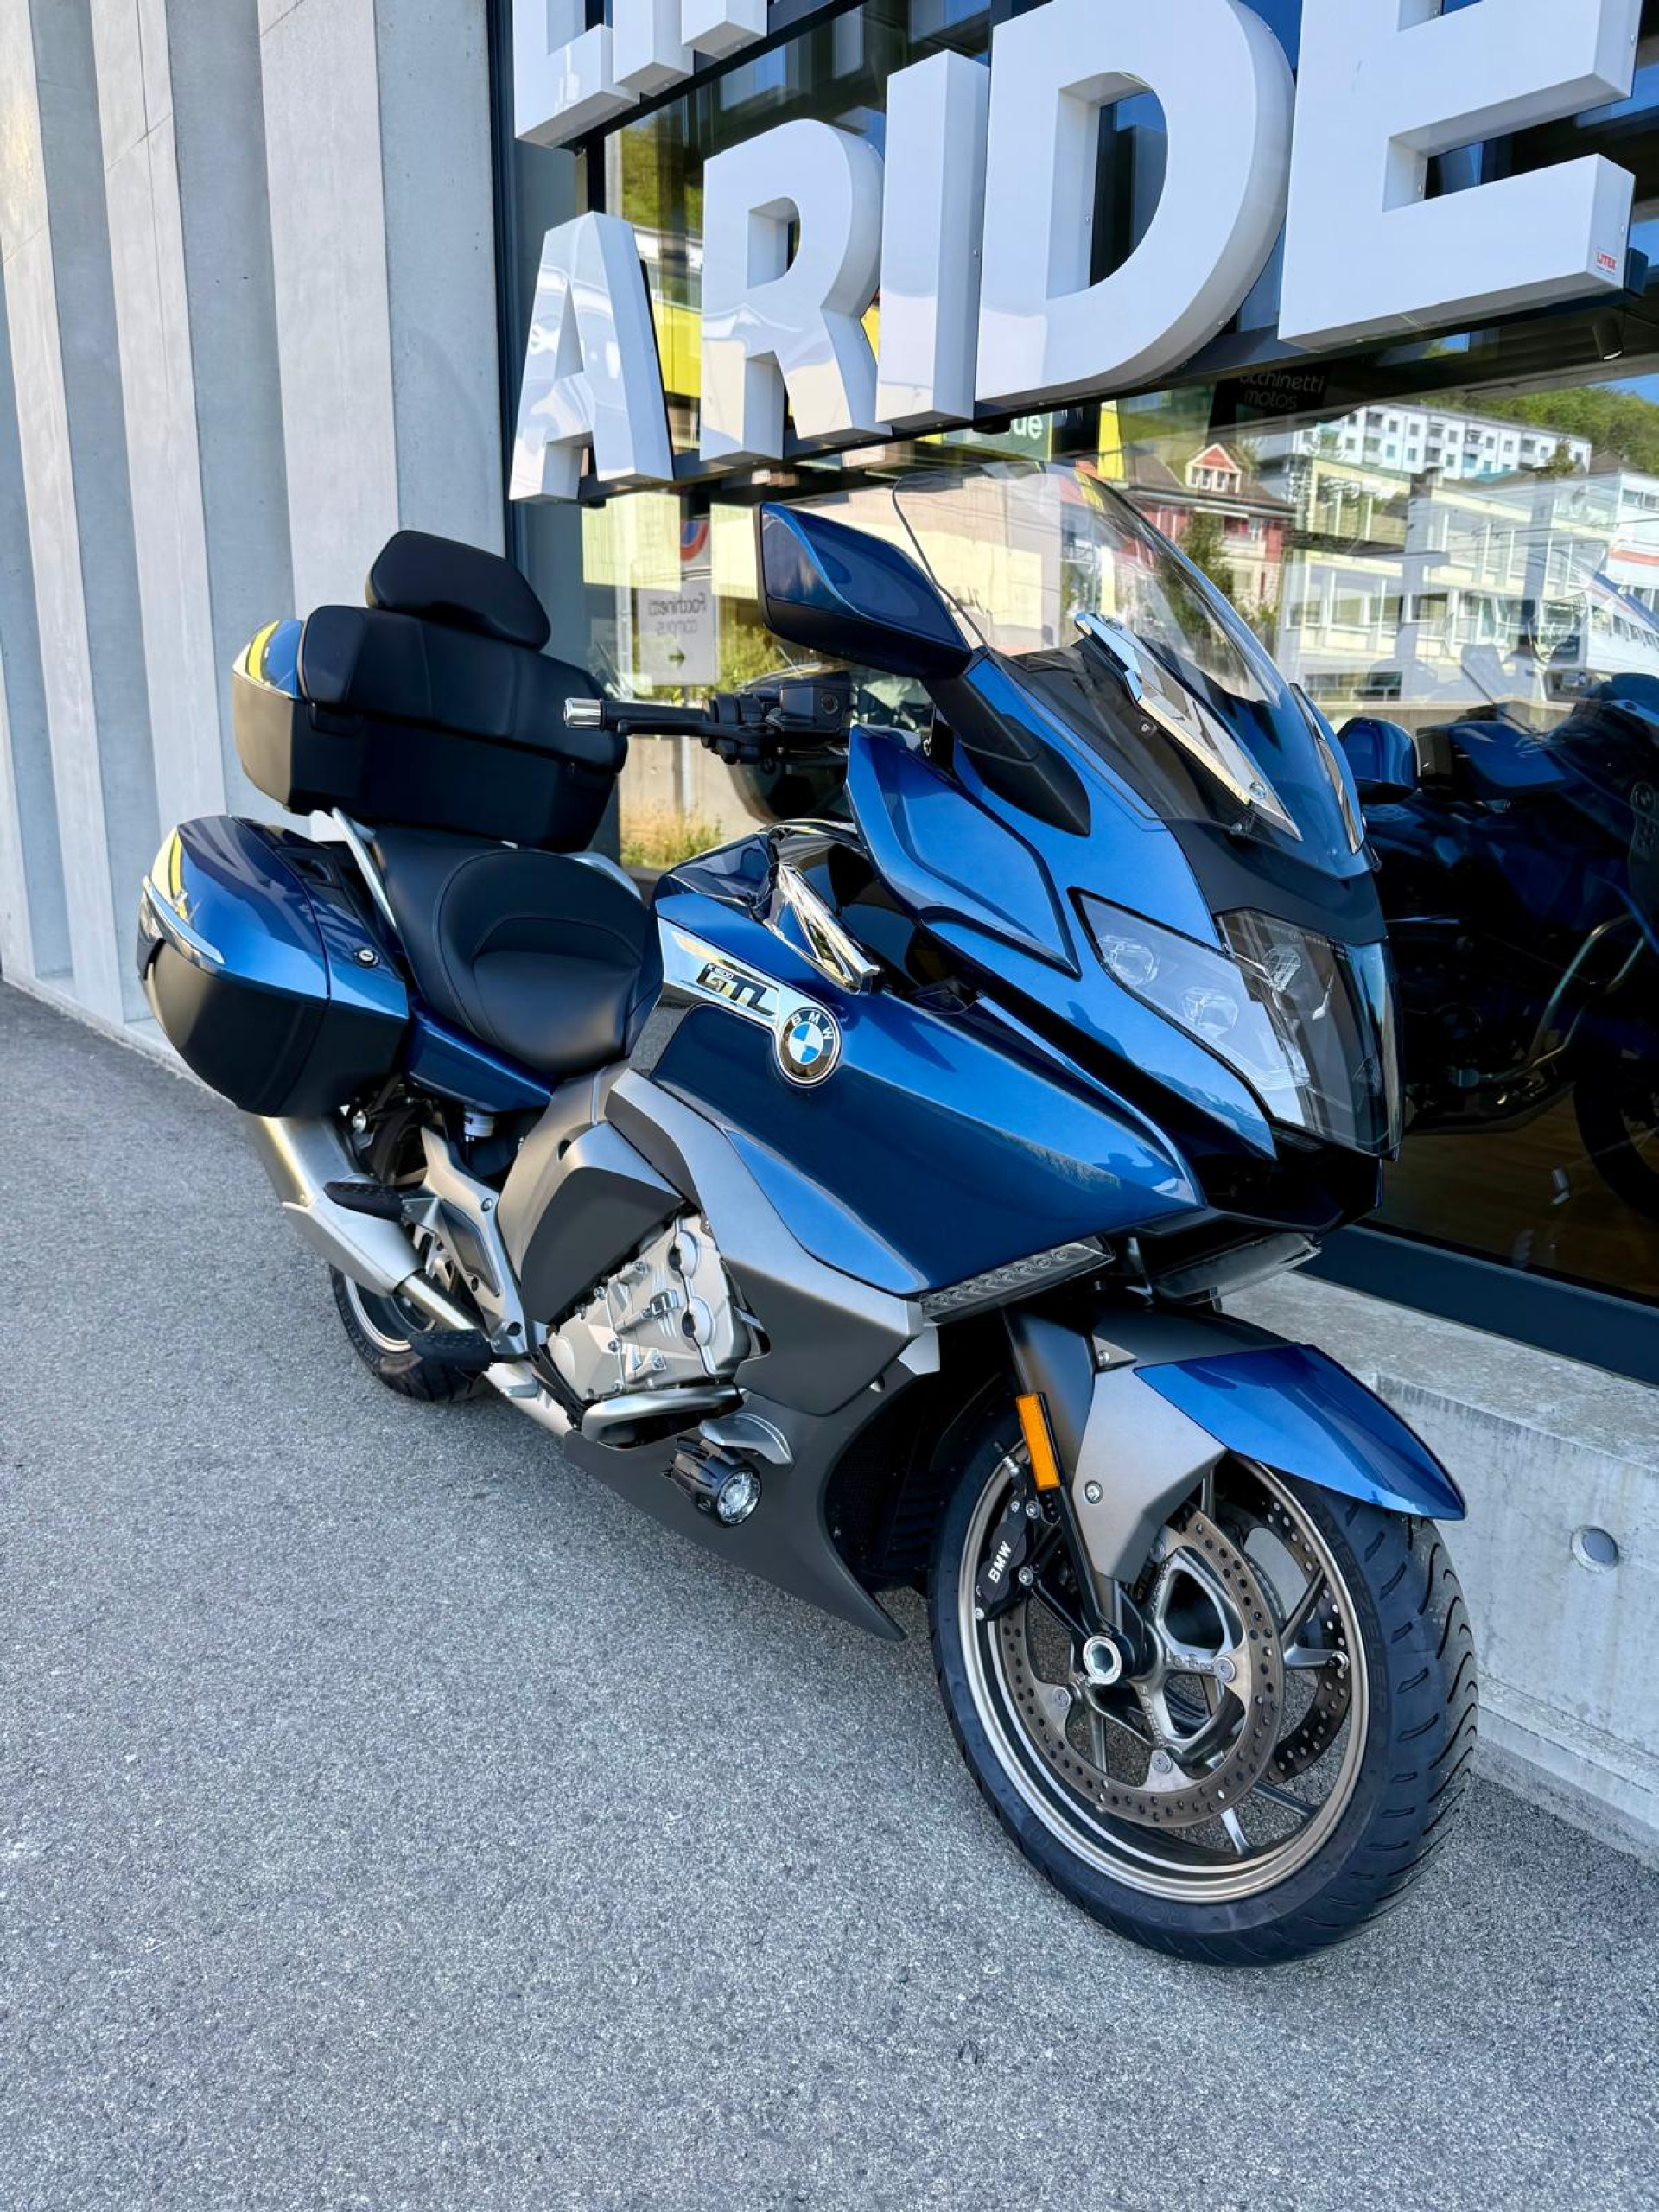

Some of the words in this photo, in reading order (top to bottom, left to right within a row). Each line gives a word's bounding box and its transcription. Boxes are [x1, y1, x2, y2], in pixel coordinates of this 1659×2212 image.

[509, 211, 673, 504] A
[699, 0, 1637, 462] RIDE
[1244, 390, 1297, 410] motos
[696, 963, 776, 1016] GTL
[791, 1011, 835, 1040] BMW
[988, 1541, 1012, 1584] BMW
